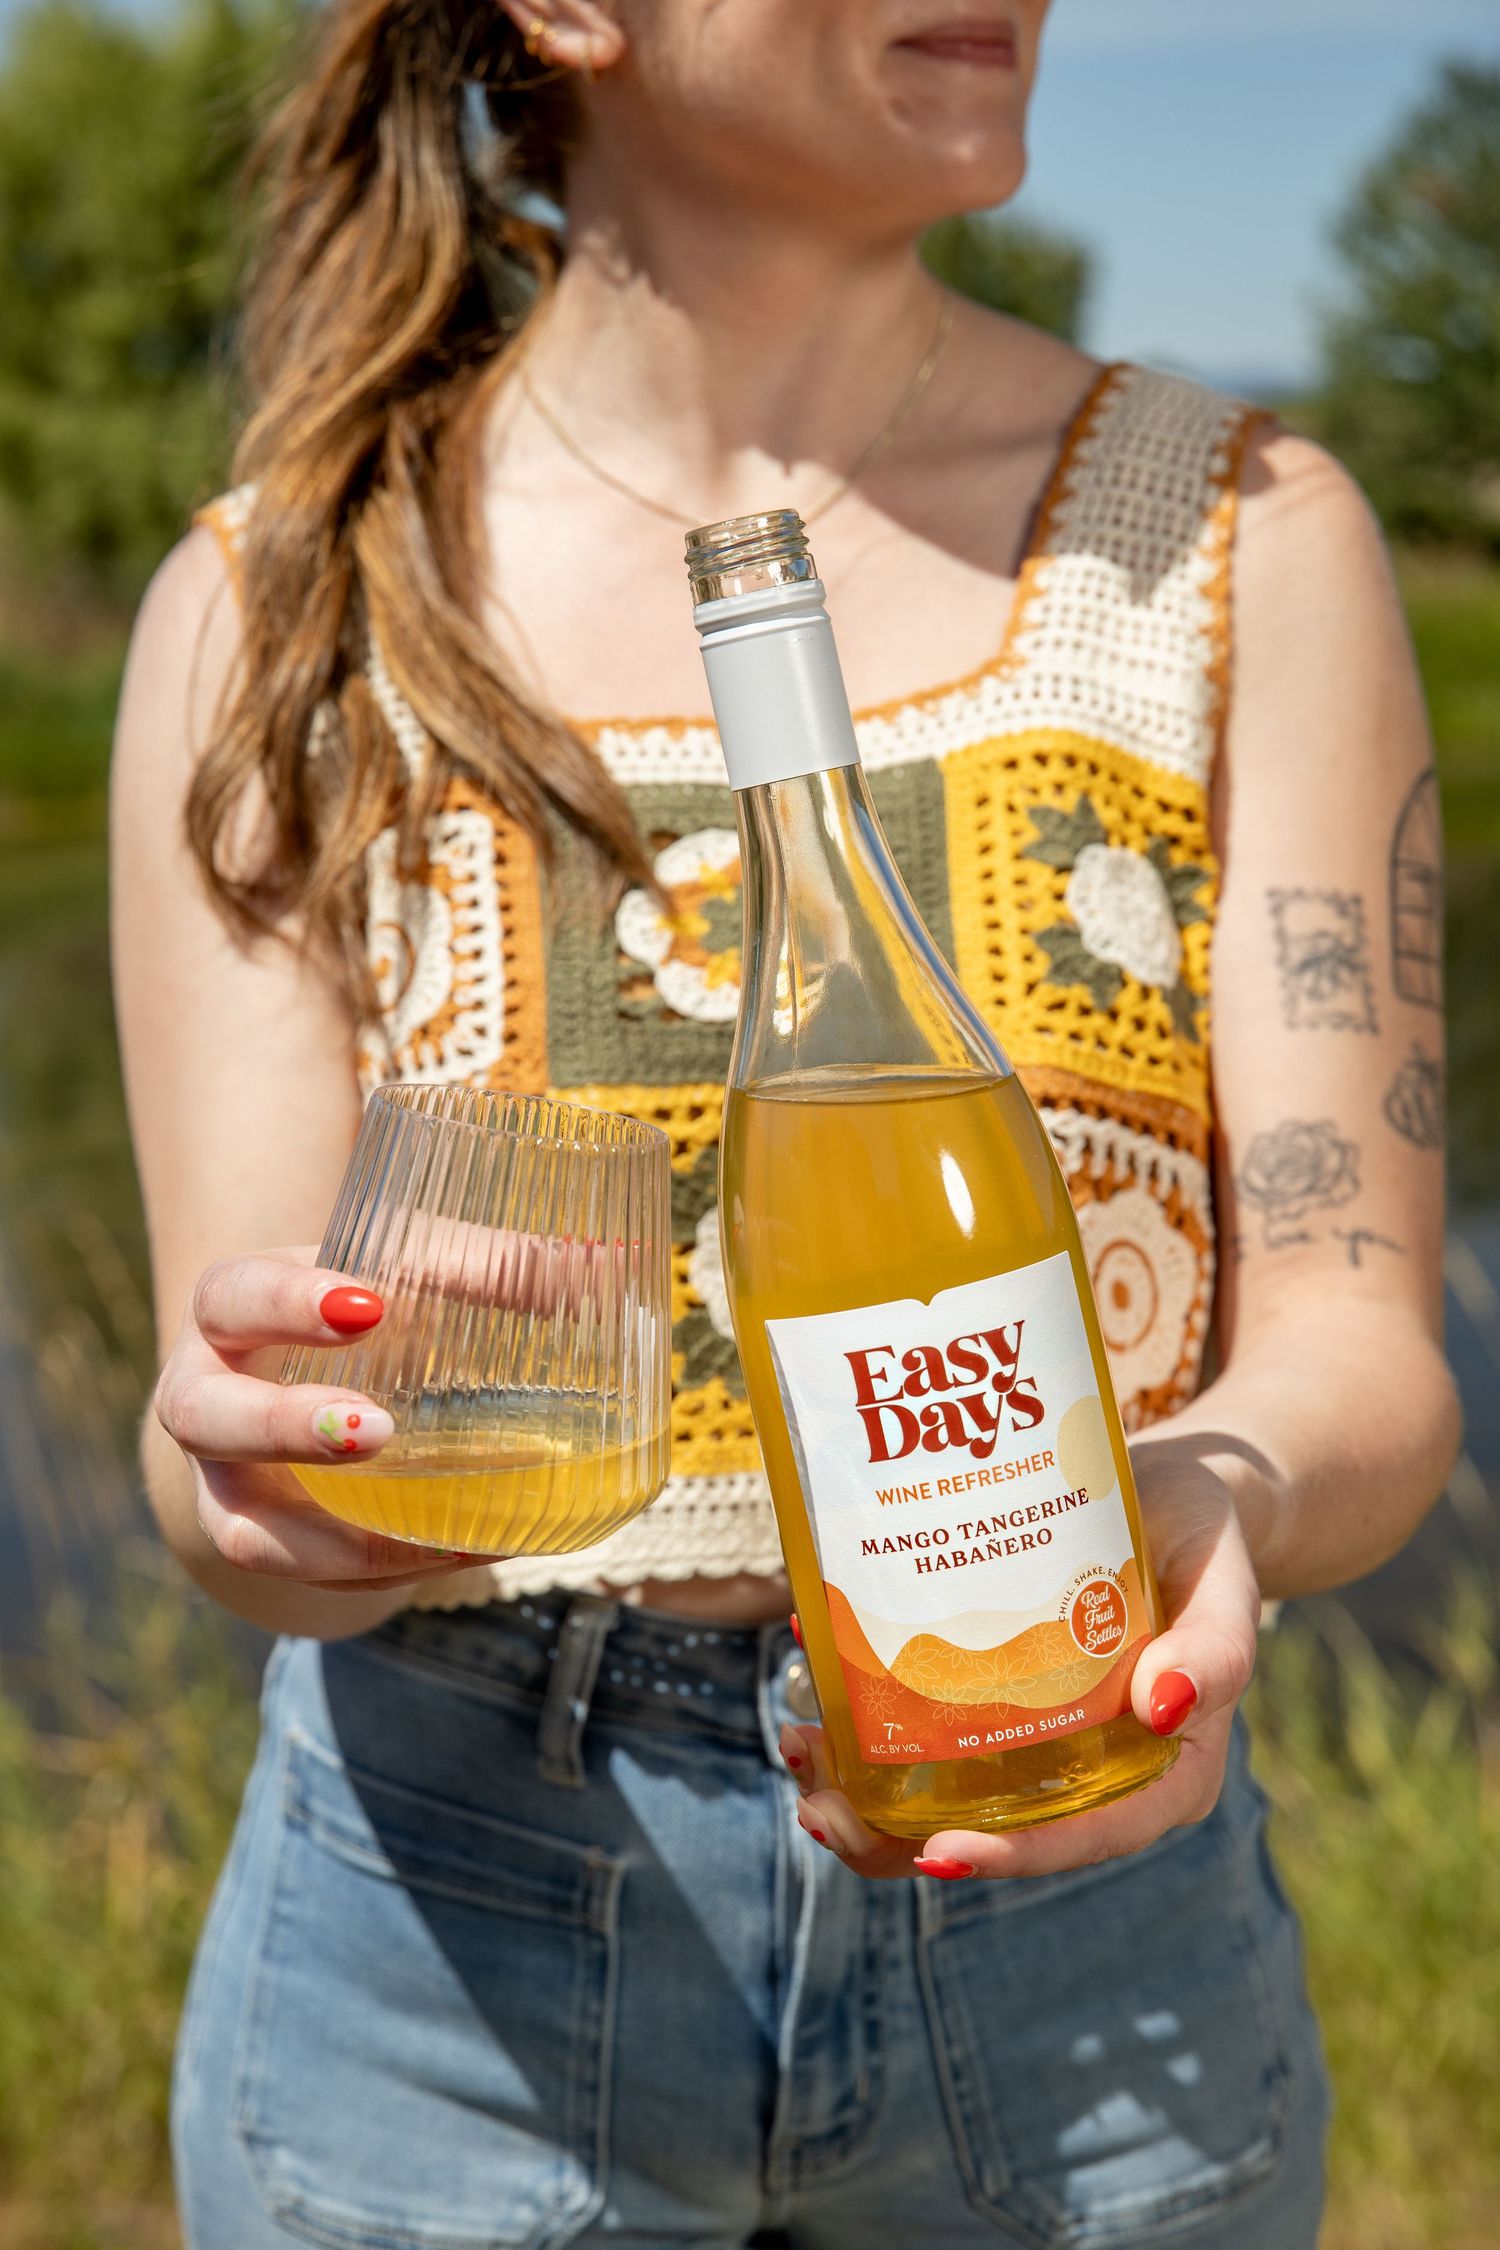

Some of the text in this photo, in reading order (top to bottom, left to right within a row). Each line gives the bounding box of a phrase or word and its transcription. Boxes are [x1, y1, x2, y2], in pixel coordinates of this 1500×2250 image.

[844, 1320, 1025, 1407] Easy
[857, 1376, 1045, 1463] Days
[876, 1450, 1055, 1506] WINE REFRESHER
[861, 1487, 1090, 1556] MANGO TANGERINE
[914, 1527, 1053, 1574] HABAÑERO
[1074, 1566, 1105, 1586] SHAKE.
[1081, 1585, 1111, 1609] Real
[1085, 1605, 1116, 1631] Fruit
[1085, 1624, 1123, 1651] Settles
[882, 1722, 904, 1741] 7%
[957, 1709, 1085, 1748] NO ADDED SUGAR
[870, 1744, 888, 1754] ALC.
[889, 1744, 900, 1754] BY
